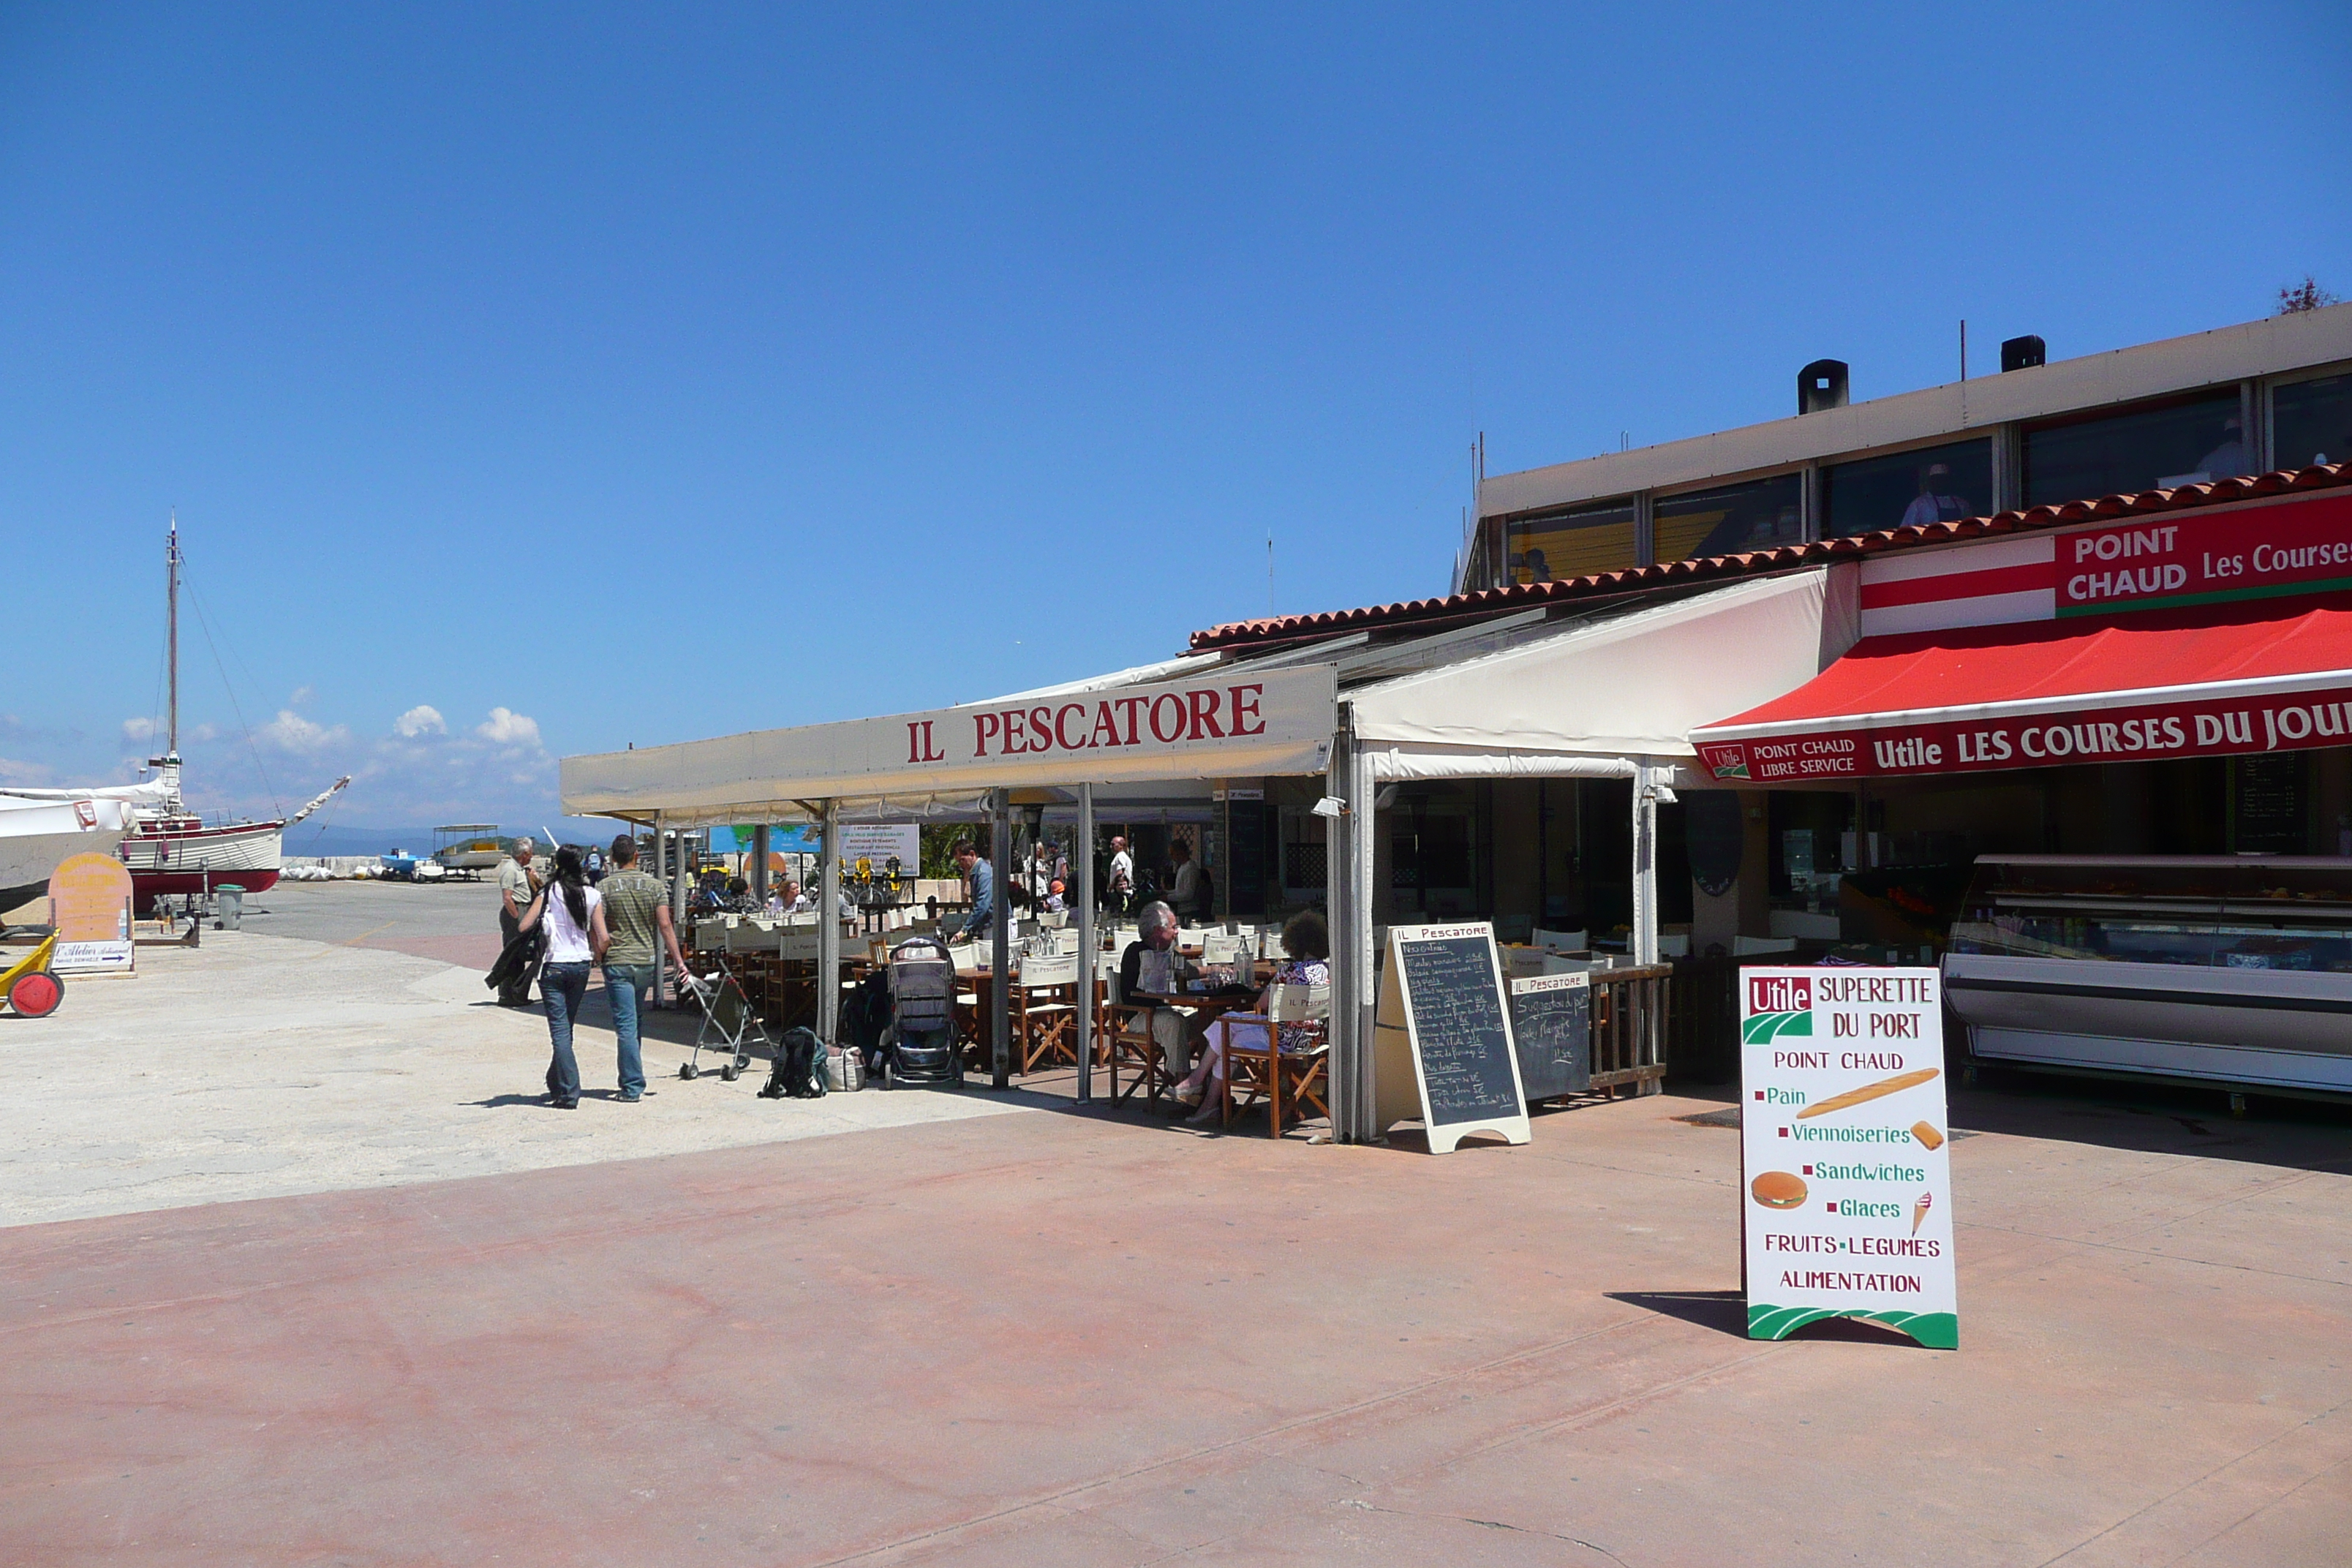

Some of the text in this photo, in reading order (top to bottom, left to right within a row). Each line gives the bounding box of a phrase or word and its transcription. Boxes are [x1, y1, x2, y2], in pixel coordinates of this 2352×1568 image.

[2076, 526, 2178, 563] POINT
[2204, 552, 2243, 578] Les
[2068, 564, 2187, 600] CHAUD
[907, 683, 1267, 764] IL PESCATORE
[1874, 701, 2352, 769] Utile LES COURSES DU JOU
[1715, 750, 1739, 767] Utile
[1754, 739, 1855, 760] POINT CHAUD
[1760, 757, 1855, 777] LIBRE SERVICE
[1398, 930, 1409, 940] IL
[1516, 981, 1524, 993] IL
[1753, 977, 1933, 1011] Utile SUPERETTE
[1833, 1013, 1921, 1039] DU PORT
[1774, 1052, 1904, 1070] POINT CHAUD
[1767, 1087, 1806, 1104] Pain
[1791, 1123, 1911, 1143] Viennoiseries
[1815, 1161, 1925, 1182] Sandwiches
[1840, 1199, 1901, 1218] Glaces
[1765, 1234, 1940, 1258] FRUITS LEGUMES
[1779, 1270, 1921, 1293] ALIMENTATION
